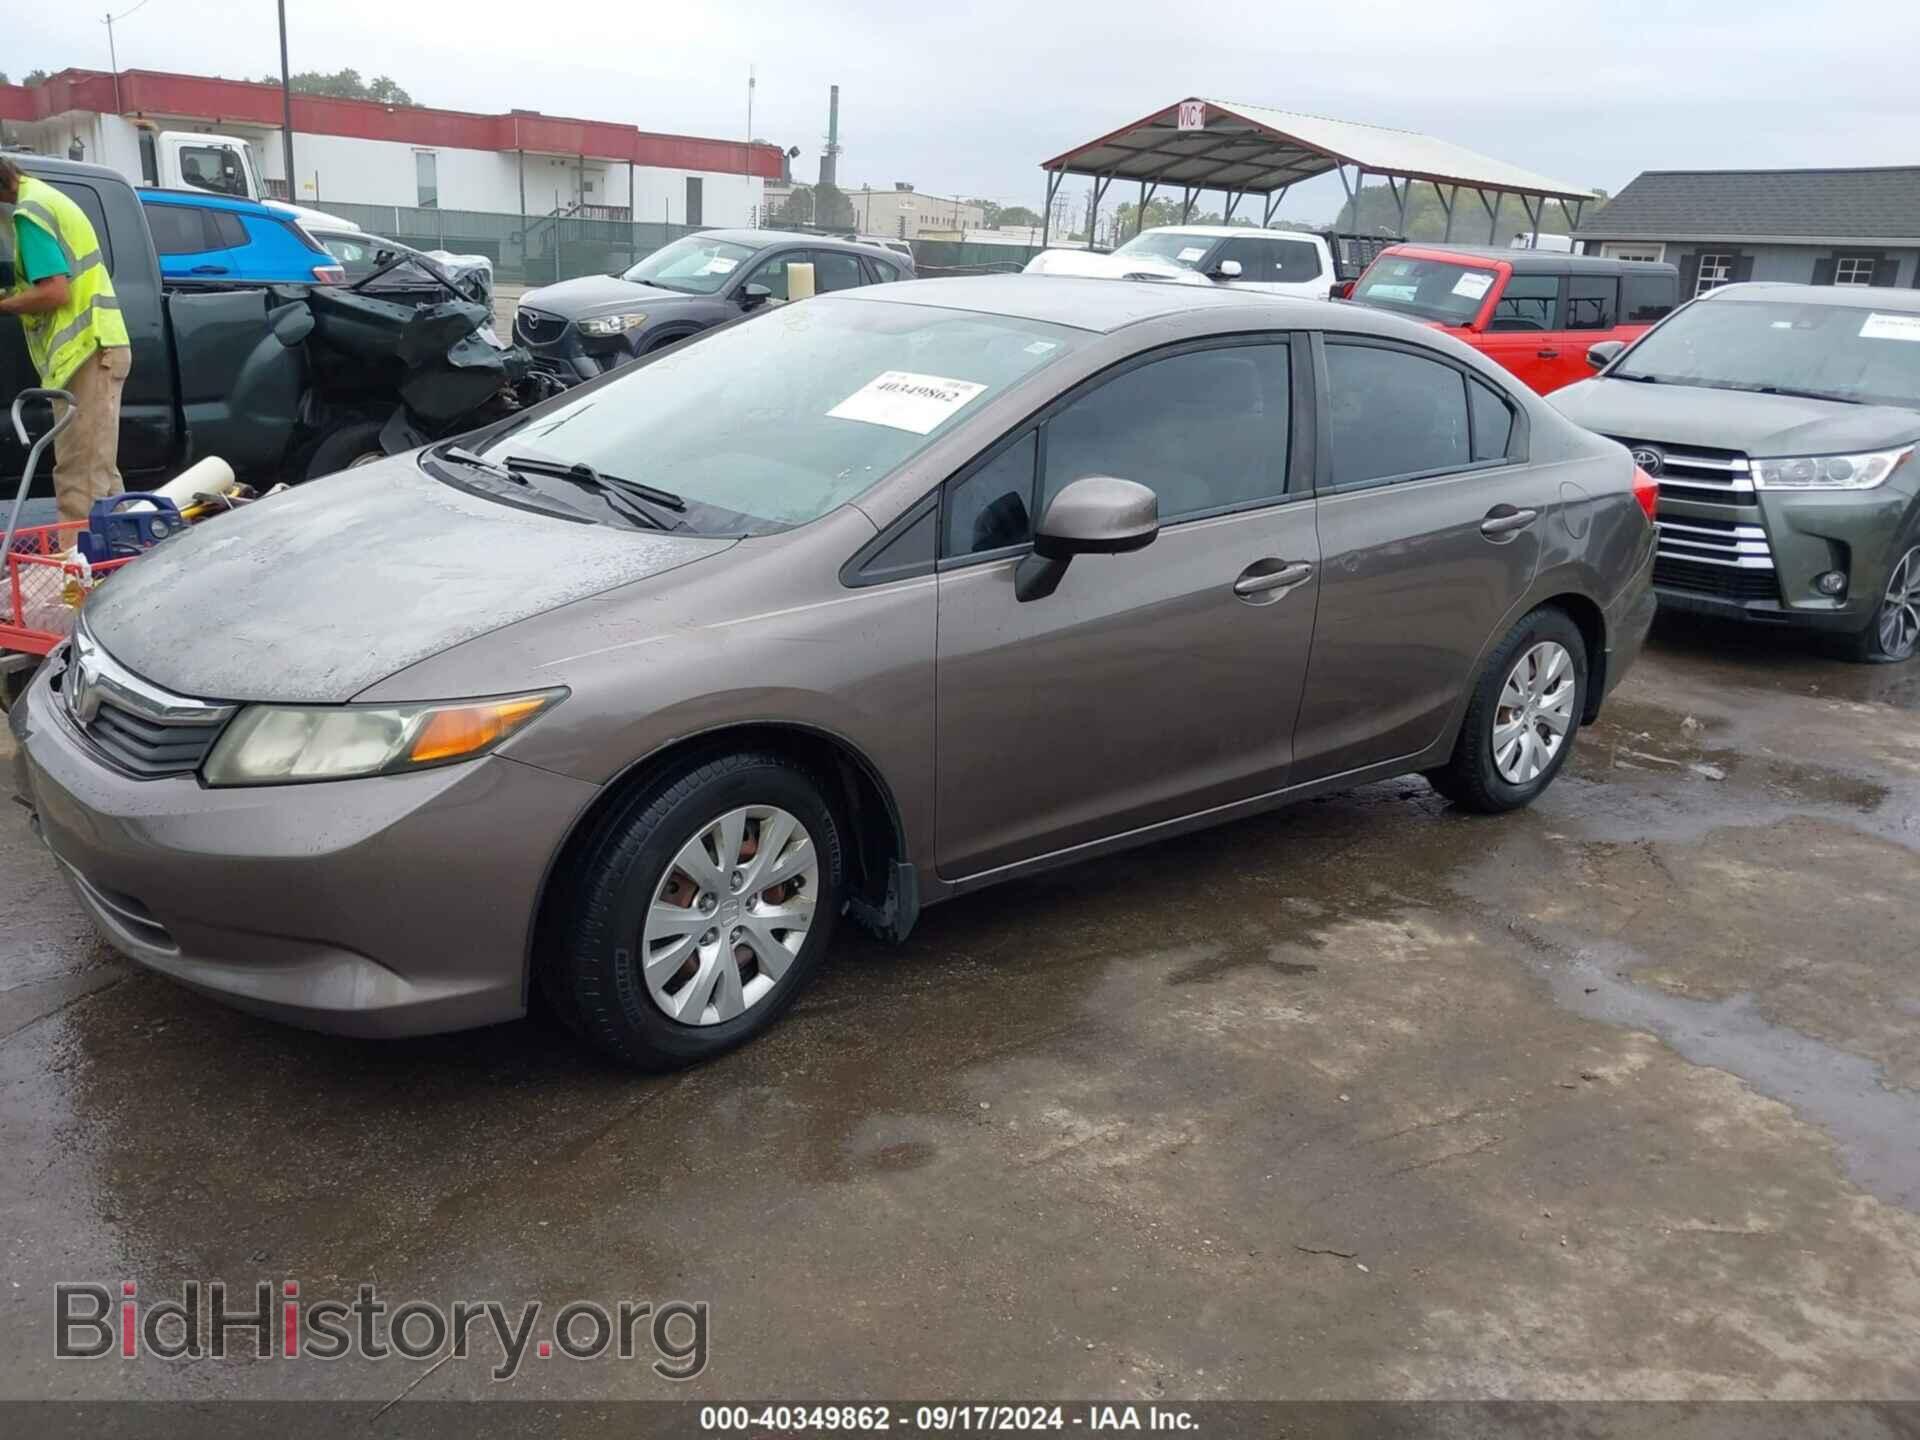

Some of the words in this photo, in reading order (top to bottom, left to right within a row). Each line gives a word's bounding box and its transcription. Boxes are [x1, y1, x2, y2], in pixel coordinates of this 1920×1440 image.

[1179, 104, 1197, 126] VIC
[1198, 104, 1205, 125] 1
[878, 382, 960, 402] 40349862
